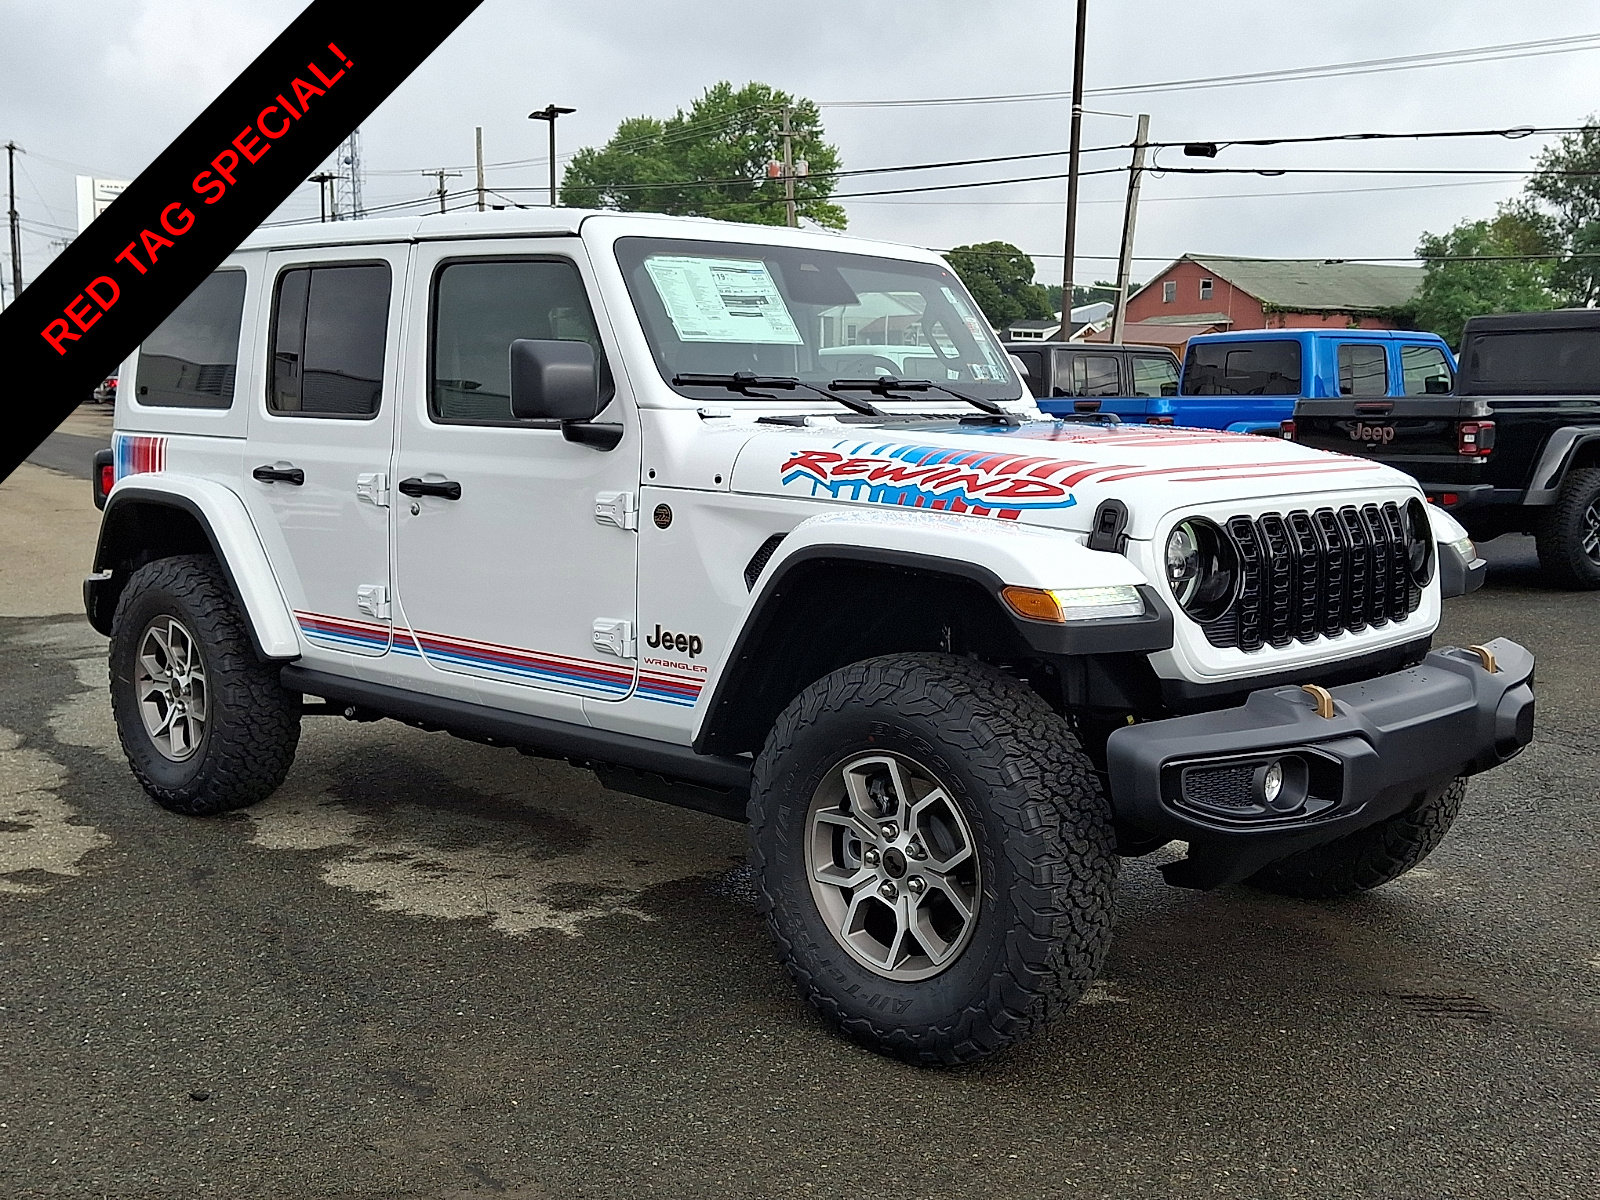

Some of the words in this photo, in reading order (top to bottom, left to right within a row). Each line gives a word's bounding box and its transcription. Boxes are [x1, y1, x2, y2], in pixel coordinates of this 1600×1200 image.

[1350, 423, 1394, 444] Jeep
[781, 450, 1066, 498] REWIND
[646, 624, 703, 658] Jeep
[643, 657, 708, 673] WRANGLER
